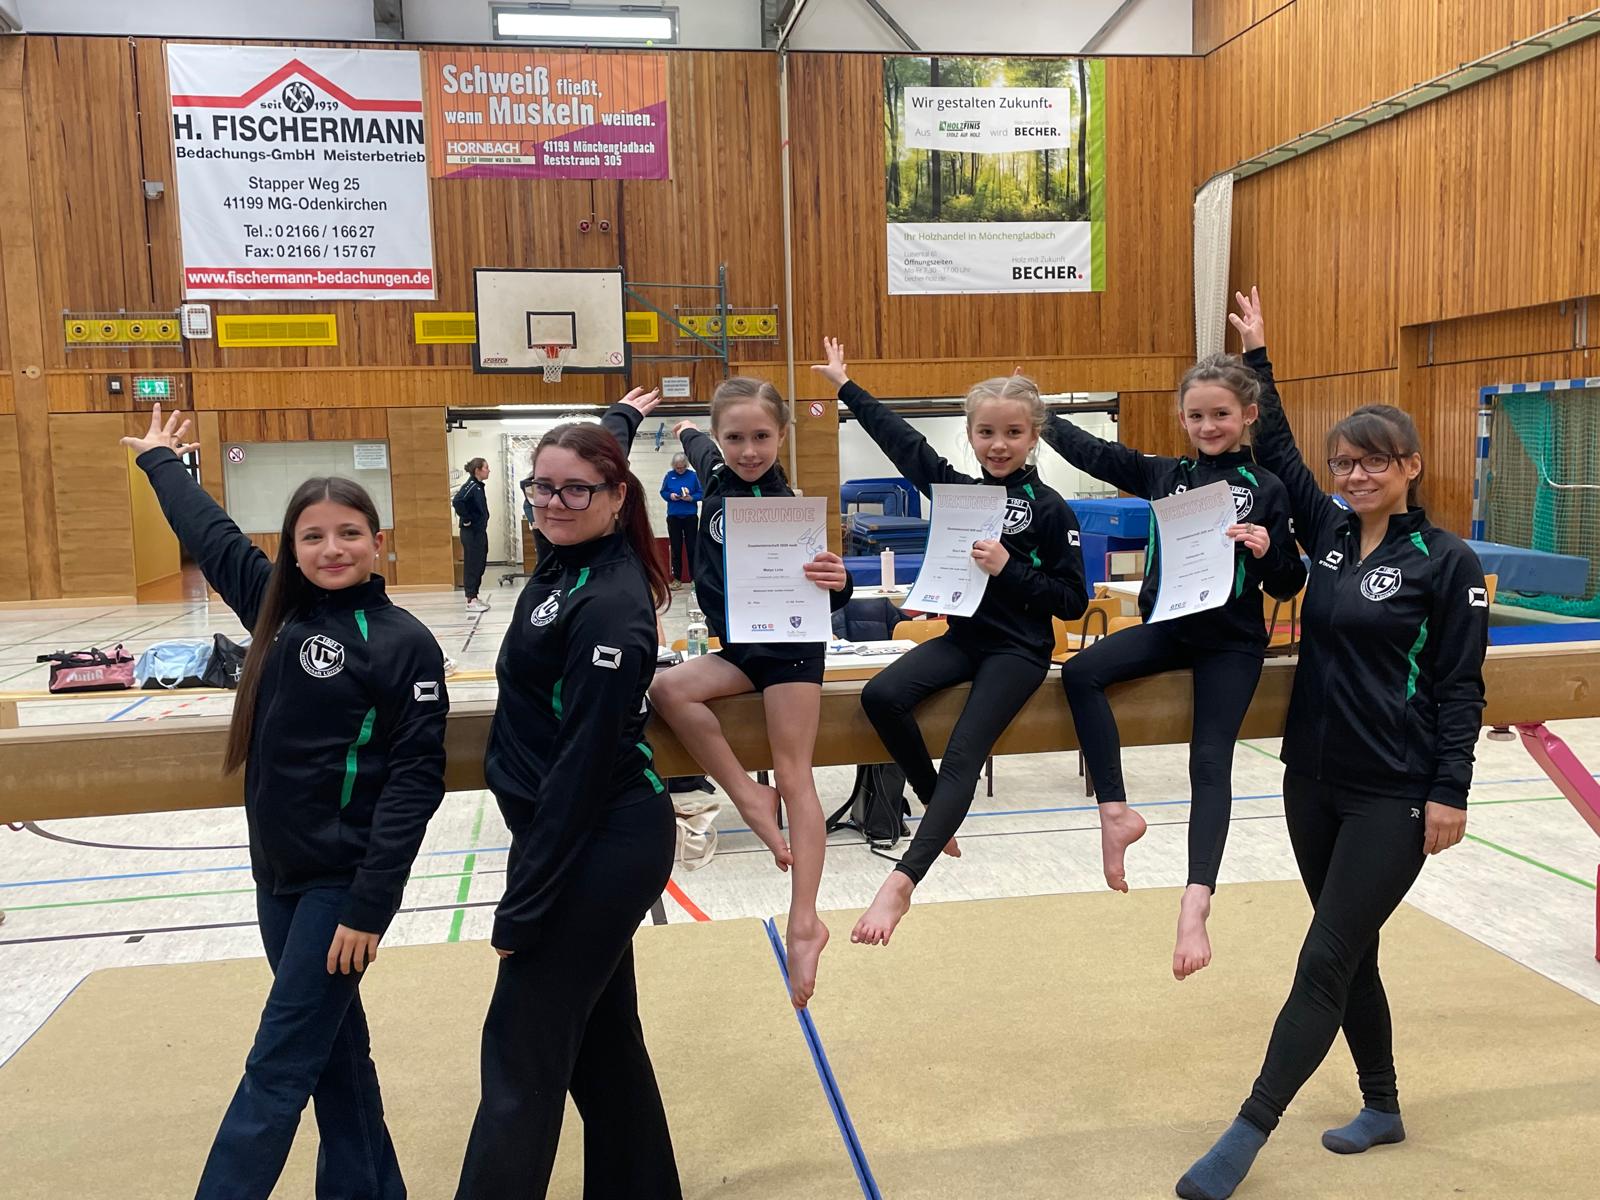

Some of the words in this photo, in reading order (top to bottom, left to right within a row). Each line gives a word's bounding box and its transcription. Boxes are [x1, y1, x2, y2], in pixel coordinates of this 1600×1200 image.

[442, 64, 549, 96] Schweiß
[556, 78, 602, 98] fließt,
[260, 100, 282, 109] seit
[314, 102, 338, 111] 1939
[444, 110, 484, 124] wenn
[489, 96, 595, 126] Muskeln
[601, 110, 656, 126] weinen.
[912, 97, 934, 108] Wir
[937, 97, 996, 111] gestalten
[1000, 96, 1053, 108] Zukunft.
[174, 114, 202, 140] H.
[212, 115, 425, 145] FISCHERMANN
[915, 128, 931, 136] Aus
[990, 128, 1008, 136] wird
[1014, 127, 1061, 137] BECHER.
[176, 146, 315, 162] Bedachungs-GmbH
[324, 149, 426, 162] Meisterbetrieb
[447, 142, 520, 154] HORNBACH
[543, 140, 570, 153] 41199
[573, 140, 656, 156] Mönchengladbach
[543, 154, 600, 166] Reststrauch
[604, 154, 622, 166] 305
[248, 176, 304, 192] Stapper
[308, 177, 340, 194] Weg
[343, 178, 360, 190] 25
[223, 196, 264, 210] 41199
[268, 196, 388, 211] MG-Odenkirchen
[904, 232, 916, 241] Ihr
[919, 232, 966, 241] Holzhandel
[968, 232, 976, 240] in
[979, 232, 1056, 242] Mönchengladbach
[904, 258, 953, 266] Öffnungszeiten
[188, 270, 430, 286] www.fischermann-bedachungen.de
[1012, 266, 1083, 280] BECHER.
[732, 508, 816, 524] URKUNDE
